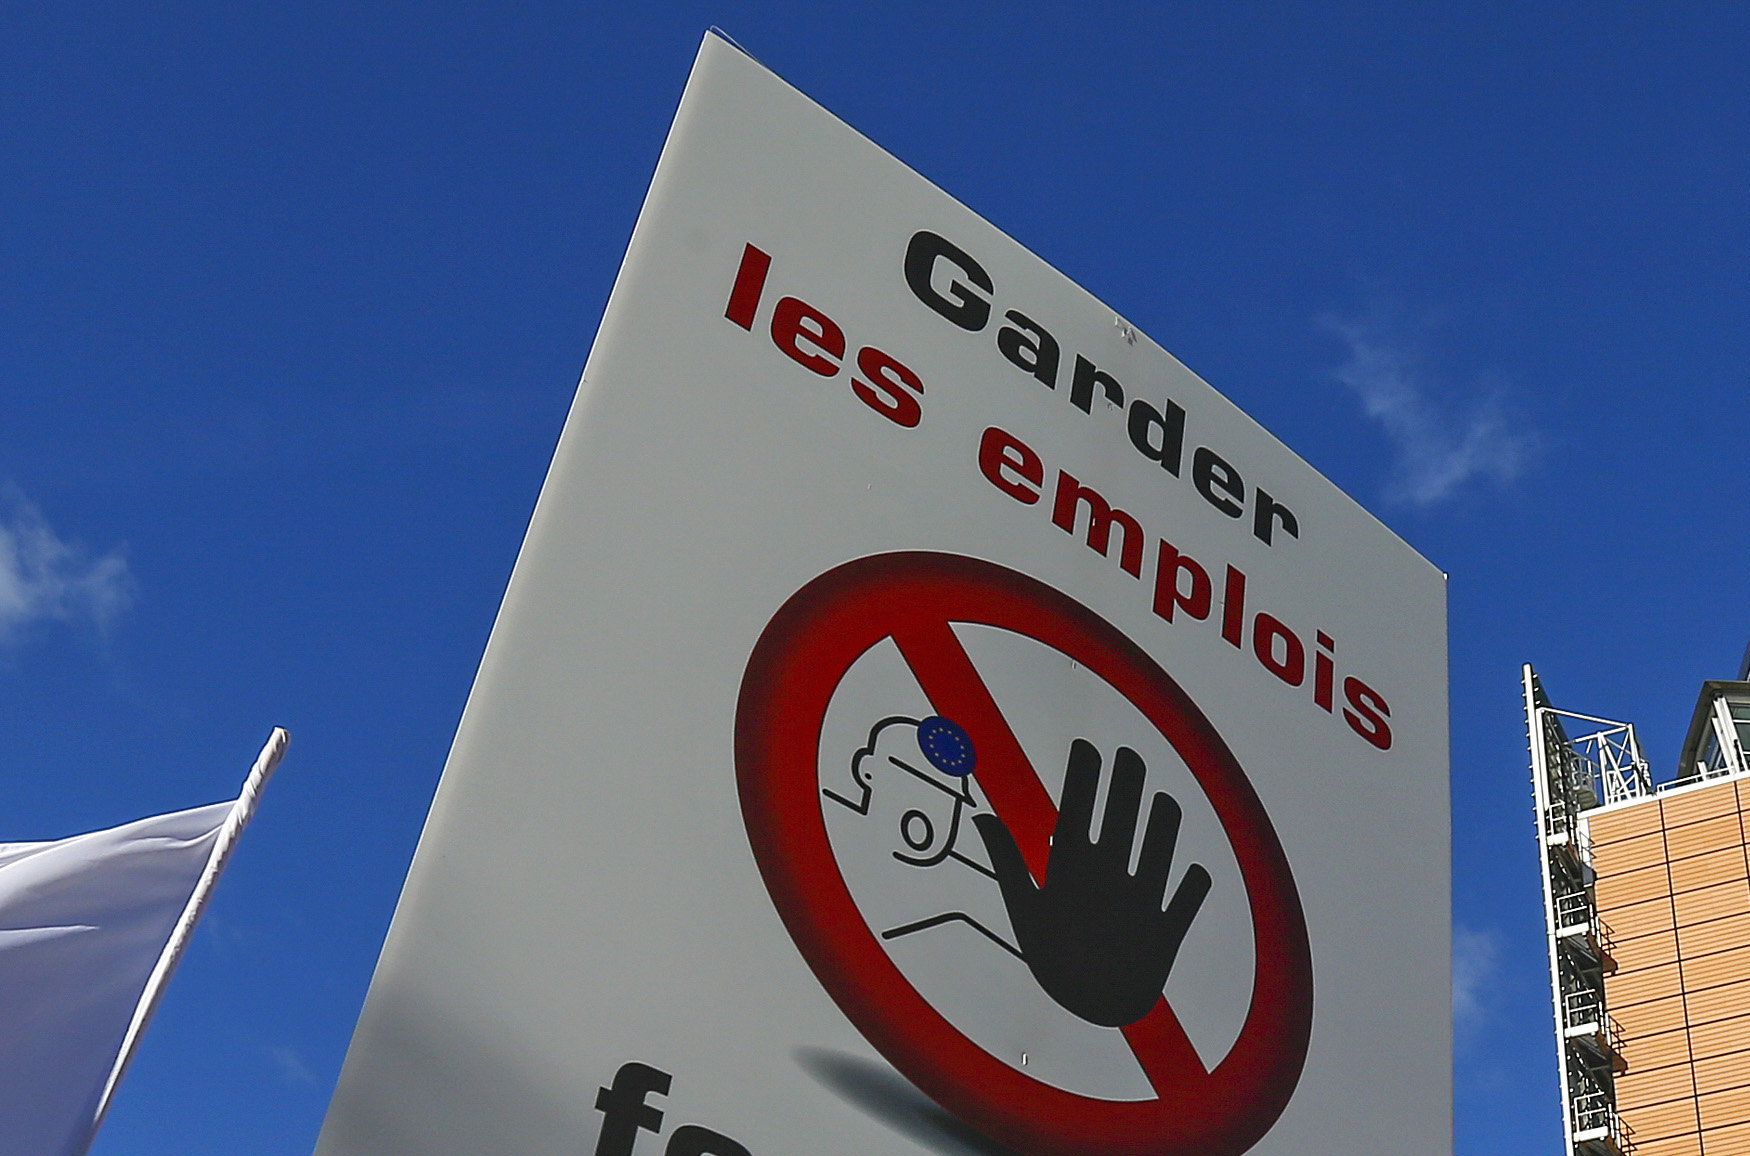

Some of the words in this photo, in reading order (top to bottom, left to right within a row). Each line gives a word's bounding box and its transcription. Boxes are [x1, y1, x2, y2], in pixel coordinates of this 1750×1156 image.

[723, 241, 925, 429] les
[977, 425, 1393, 752] emplois
[904, 230, 1299, 547] Garder
